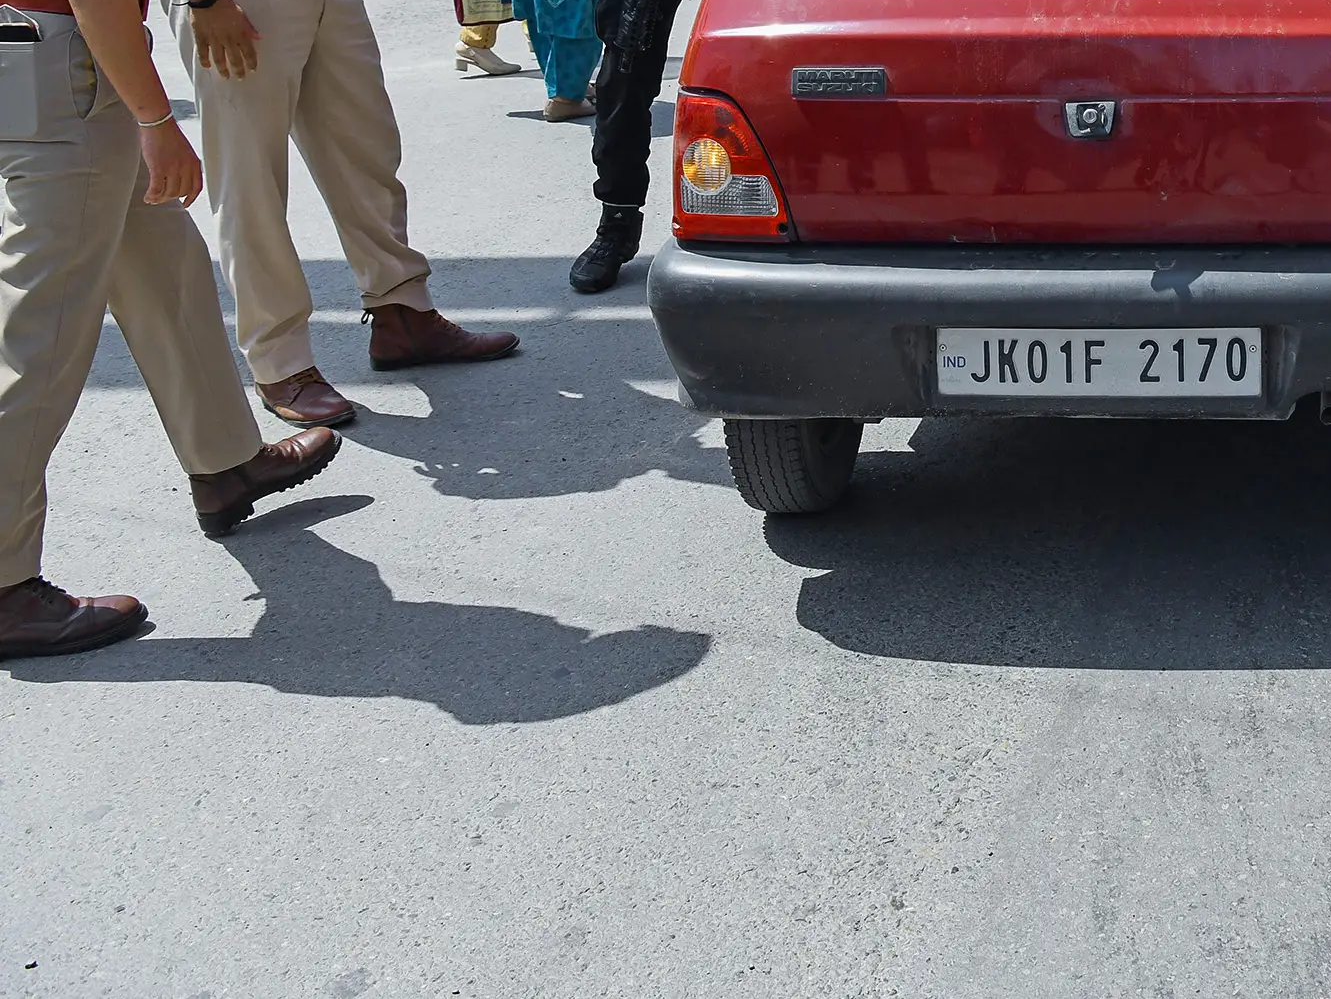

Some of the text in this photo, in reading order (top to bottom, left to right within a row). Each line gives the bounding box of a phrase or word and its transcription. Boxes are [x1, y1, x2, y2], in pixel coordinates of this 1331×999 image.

[797, 70, 879, 82] MARUTI
[797, 82, 879, 94] SUZUKI
[943, 356, 966, 368] IND
[970, 337, 1247, 384] JK01F 2170
